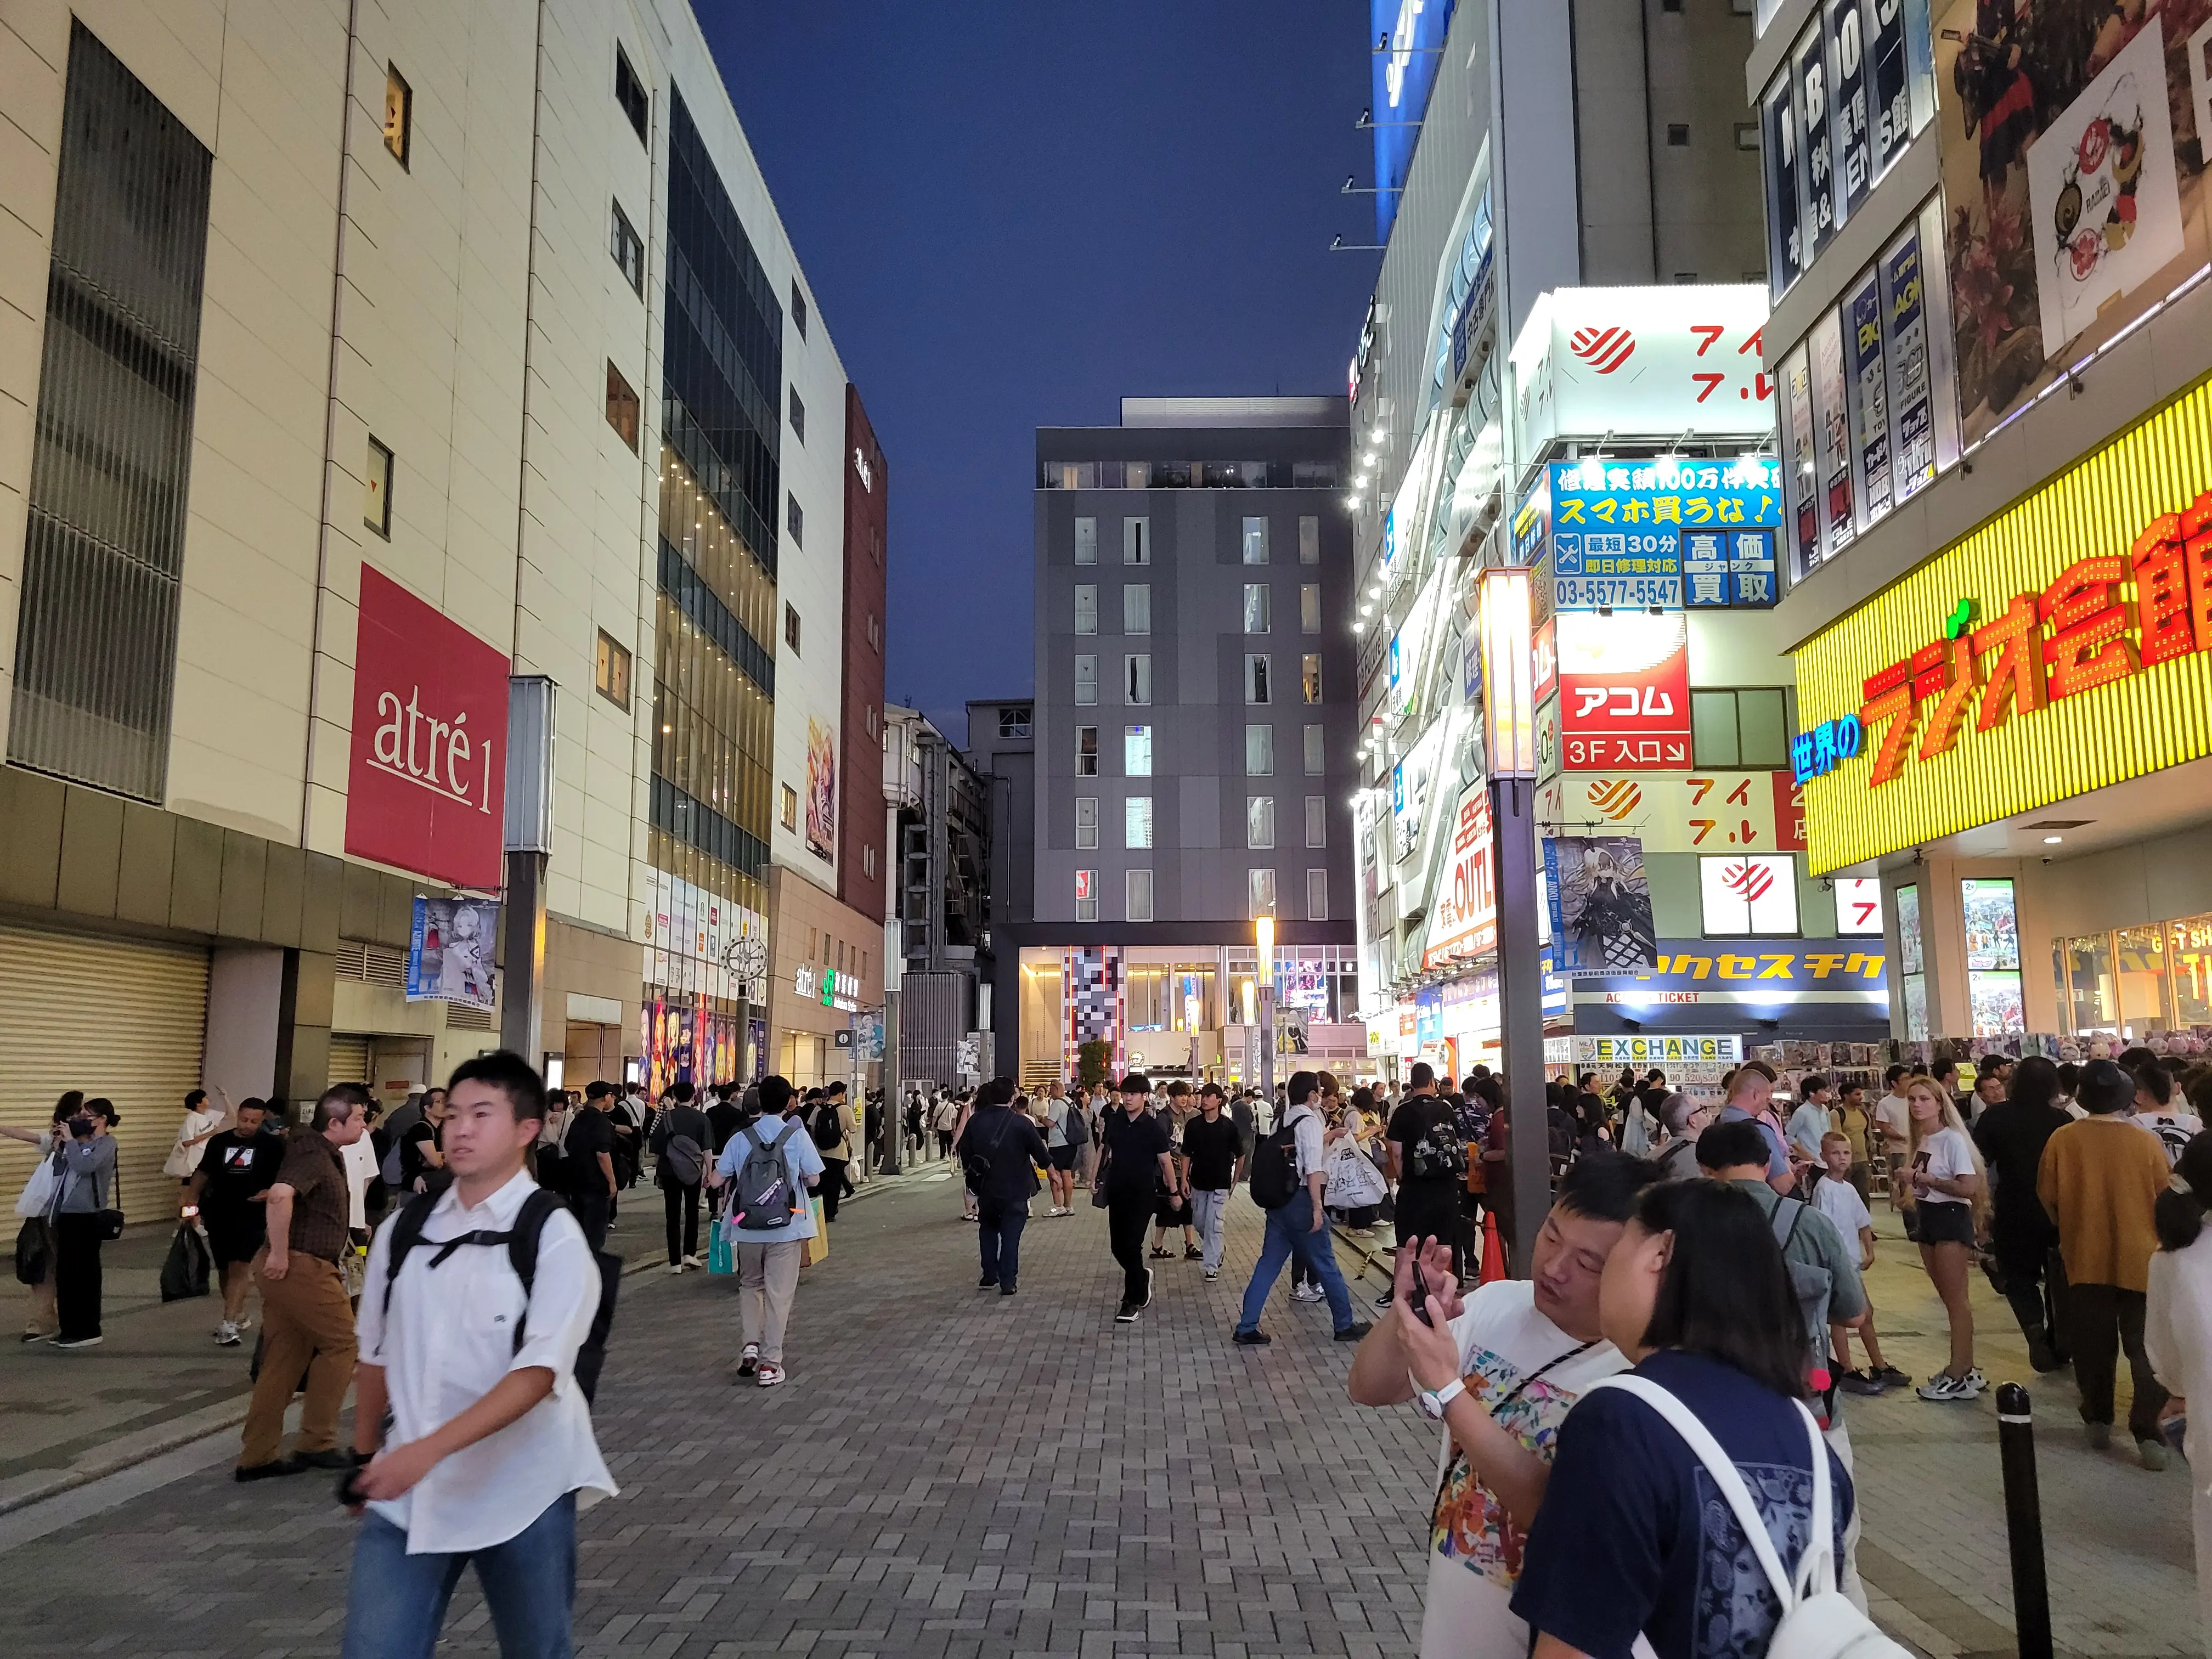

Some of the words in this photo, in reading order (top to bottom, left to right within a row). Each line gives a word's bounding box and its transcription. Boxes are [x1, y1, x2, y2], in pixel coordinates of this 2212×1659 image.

[1900, 380, 1926, 410] FIGURE
[1588, 538, 1622, 554] 最短
[1628, 534, 1678, 554] 30分
[1585, 558, 1678, 574] 即日修理対応
[1705, 562, 1753, 572] ジャンク
[1556, 580, 1679, 605] 03-5577-5547
[1575, 686, 1675, 718] アコム
[374, 685, 470, 795] atré
[1570, 741, 1606, 763] 3F
[1614, 741, 1661, 763] 入口
[1791, 712, 1860, 786] 世界の
[1686, 778, 1751, 806] アイ
[1689, 820, 1757, 845] フル
[1455, 842, 1496, 923] OUTL
[823, 968, 834, 996] JR
[1657, 993, 1699, 1003] TICKET
[1597, 1039, 1733, 1056] EXCHANGE
